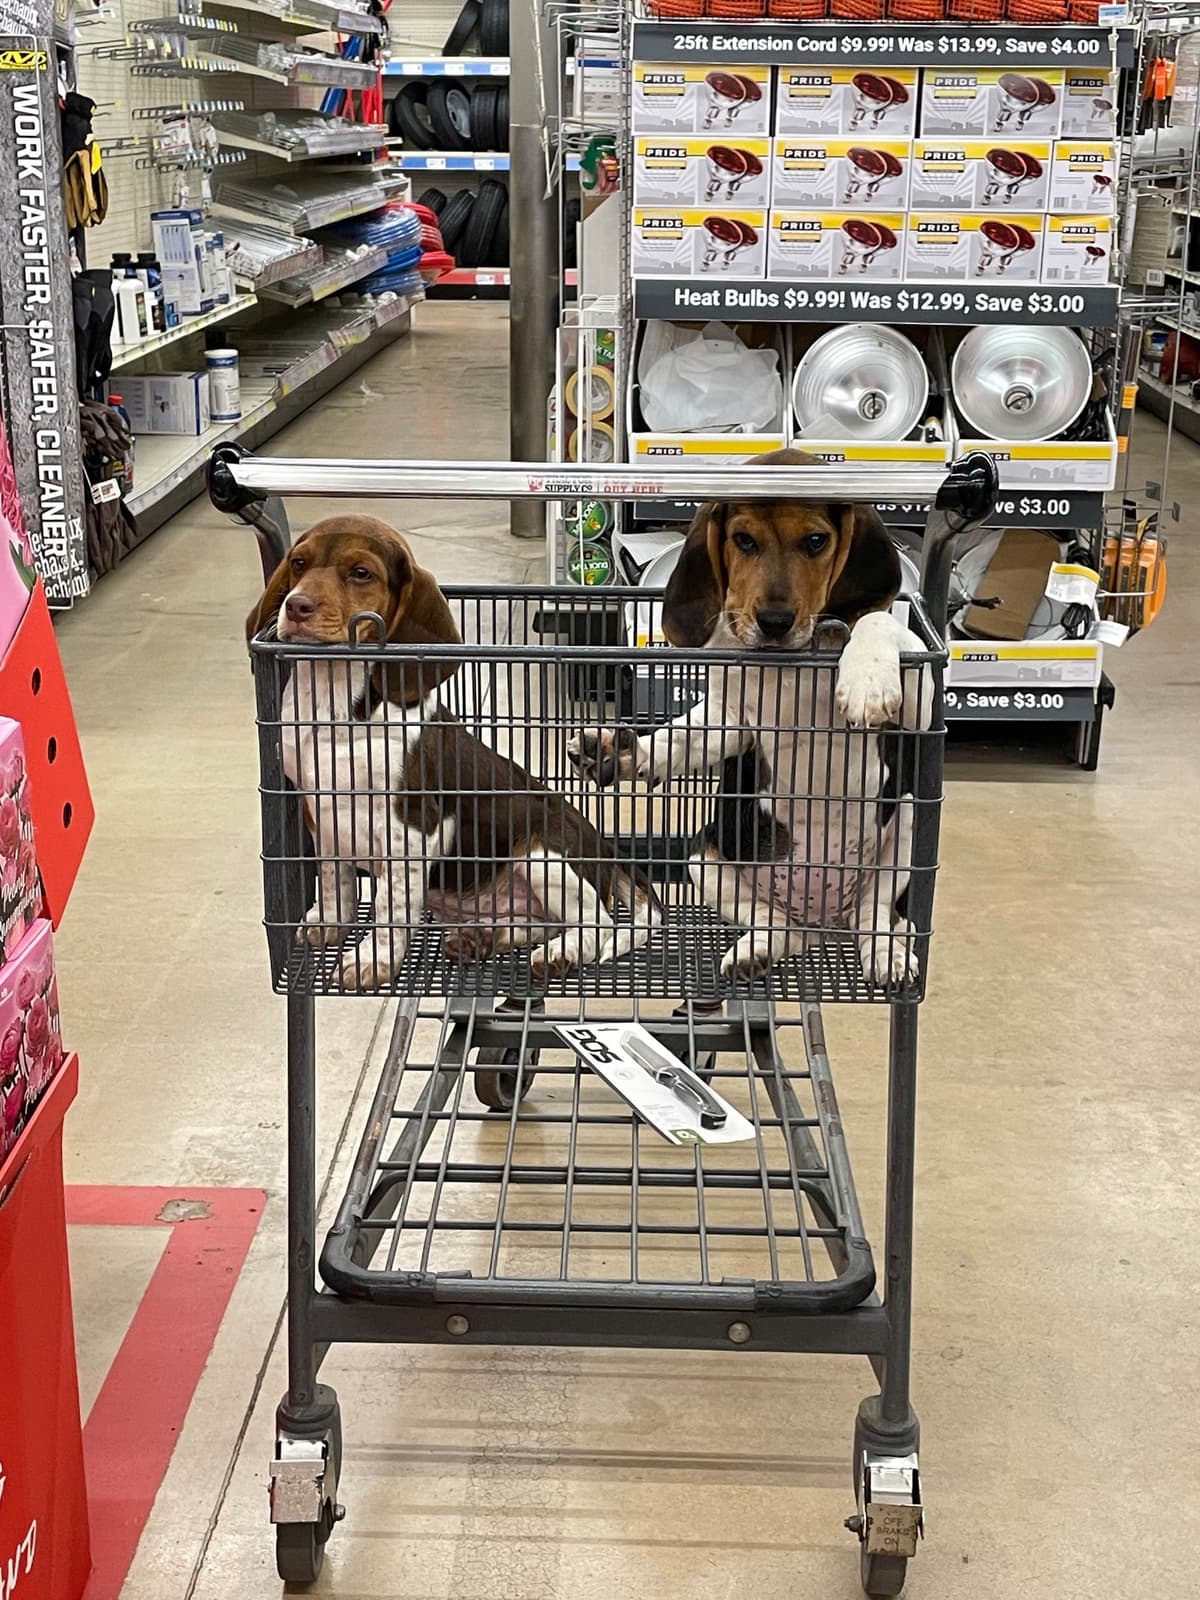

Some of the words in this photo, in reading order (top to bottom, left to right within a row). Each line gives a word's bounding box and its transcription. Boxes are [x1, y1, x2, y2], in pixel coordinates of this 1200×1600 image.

[673, 35, 709, 50] 25ft
[712, 36, 793, 51] Extension
[797, 36, 837, 52] Cord
[841, 35, 894, 54] $9.99!
[898, 37, 934, 53] Was
[938, 36, 1001, 55] $13.99,
[1005, 38, 1047, 53] Save
[1051, 37, 1099, 55] $4.00
[644, 74, 684, 83] PRIDE
[790, 76, 831, 85] PRIDE
[935, 77, 977, 86] PRIDE
[1070, 79, 1102, 87] PRIDE
[12, 83, 44, 180] WORK
[646, 148, 686, 157] PRIDE
[785, 149, 826, 158] PRIDE
[924, 152, 965, 160] PRIDE
[643, 219, 683, 228] PRIDE
[781, 222, 821, 230] PRIDE
[918, 224, 959, 232] PRIDE
[19, 188, 51, 313] FASTER,
[674, 288, 720, 306] Heat
[725, 288, 779, 307] Bulbs
[784, 288, 845, 309] $9.99!
[850, 291, 892, 309] Was
[897, 289, 970, 314] $12.99,
[974, 293, 1024, 312] Save
[1028, 292, 1085, 314] $3.00
[28, 319, 59, 422] SAFER,
[648, 447, 683, 456] PRIDE
[36, 429, 67, 557] CLEANER
[544, 484, 581, 493] SUPPLY
[995, 502, 1015, 514] ve
[1019, 497, 1070, 516] $3.00
[963, 654, 997, 662] PRIDE
[967, 693, 1010, 708] Save
[1014, 691, 1064, 709] $3.00
[566, 1028, 624, 1064] SOG
[876, 1527, 912, 1536] BRAKE
[884, 1537, 898, 1545] ON
